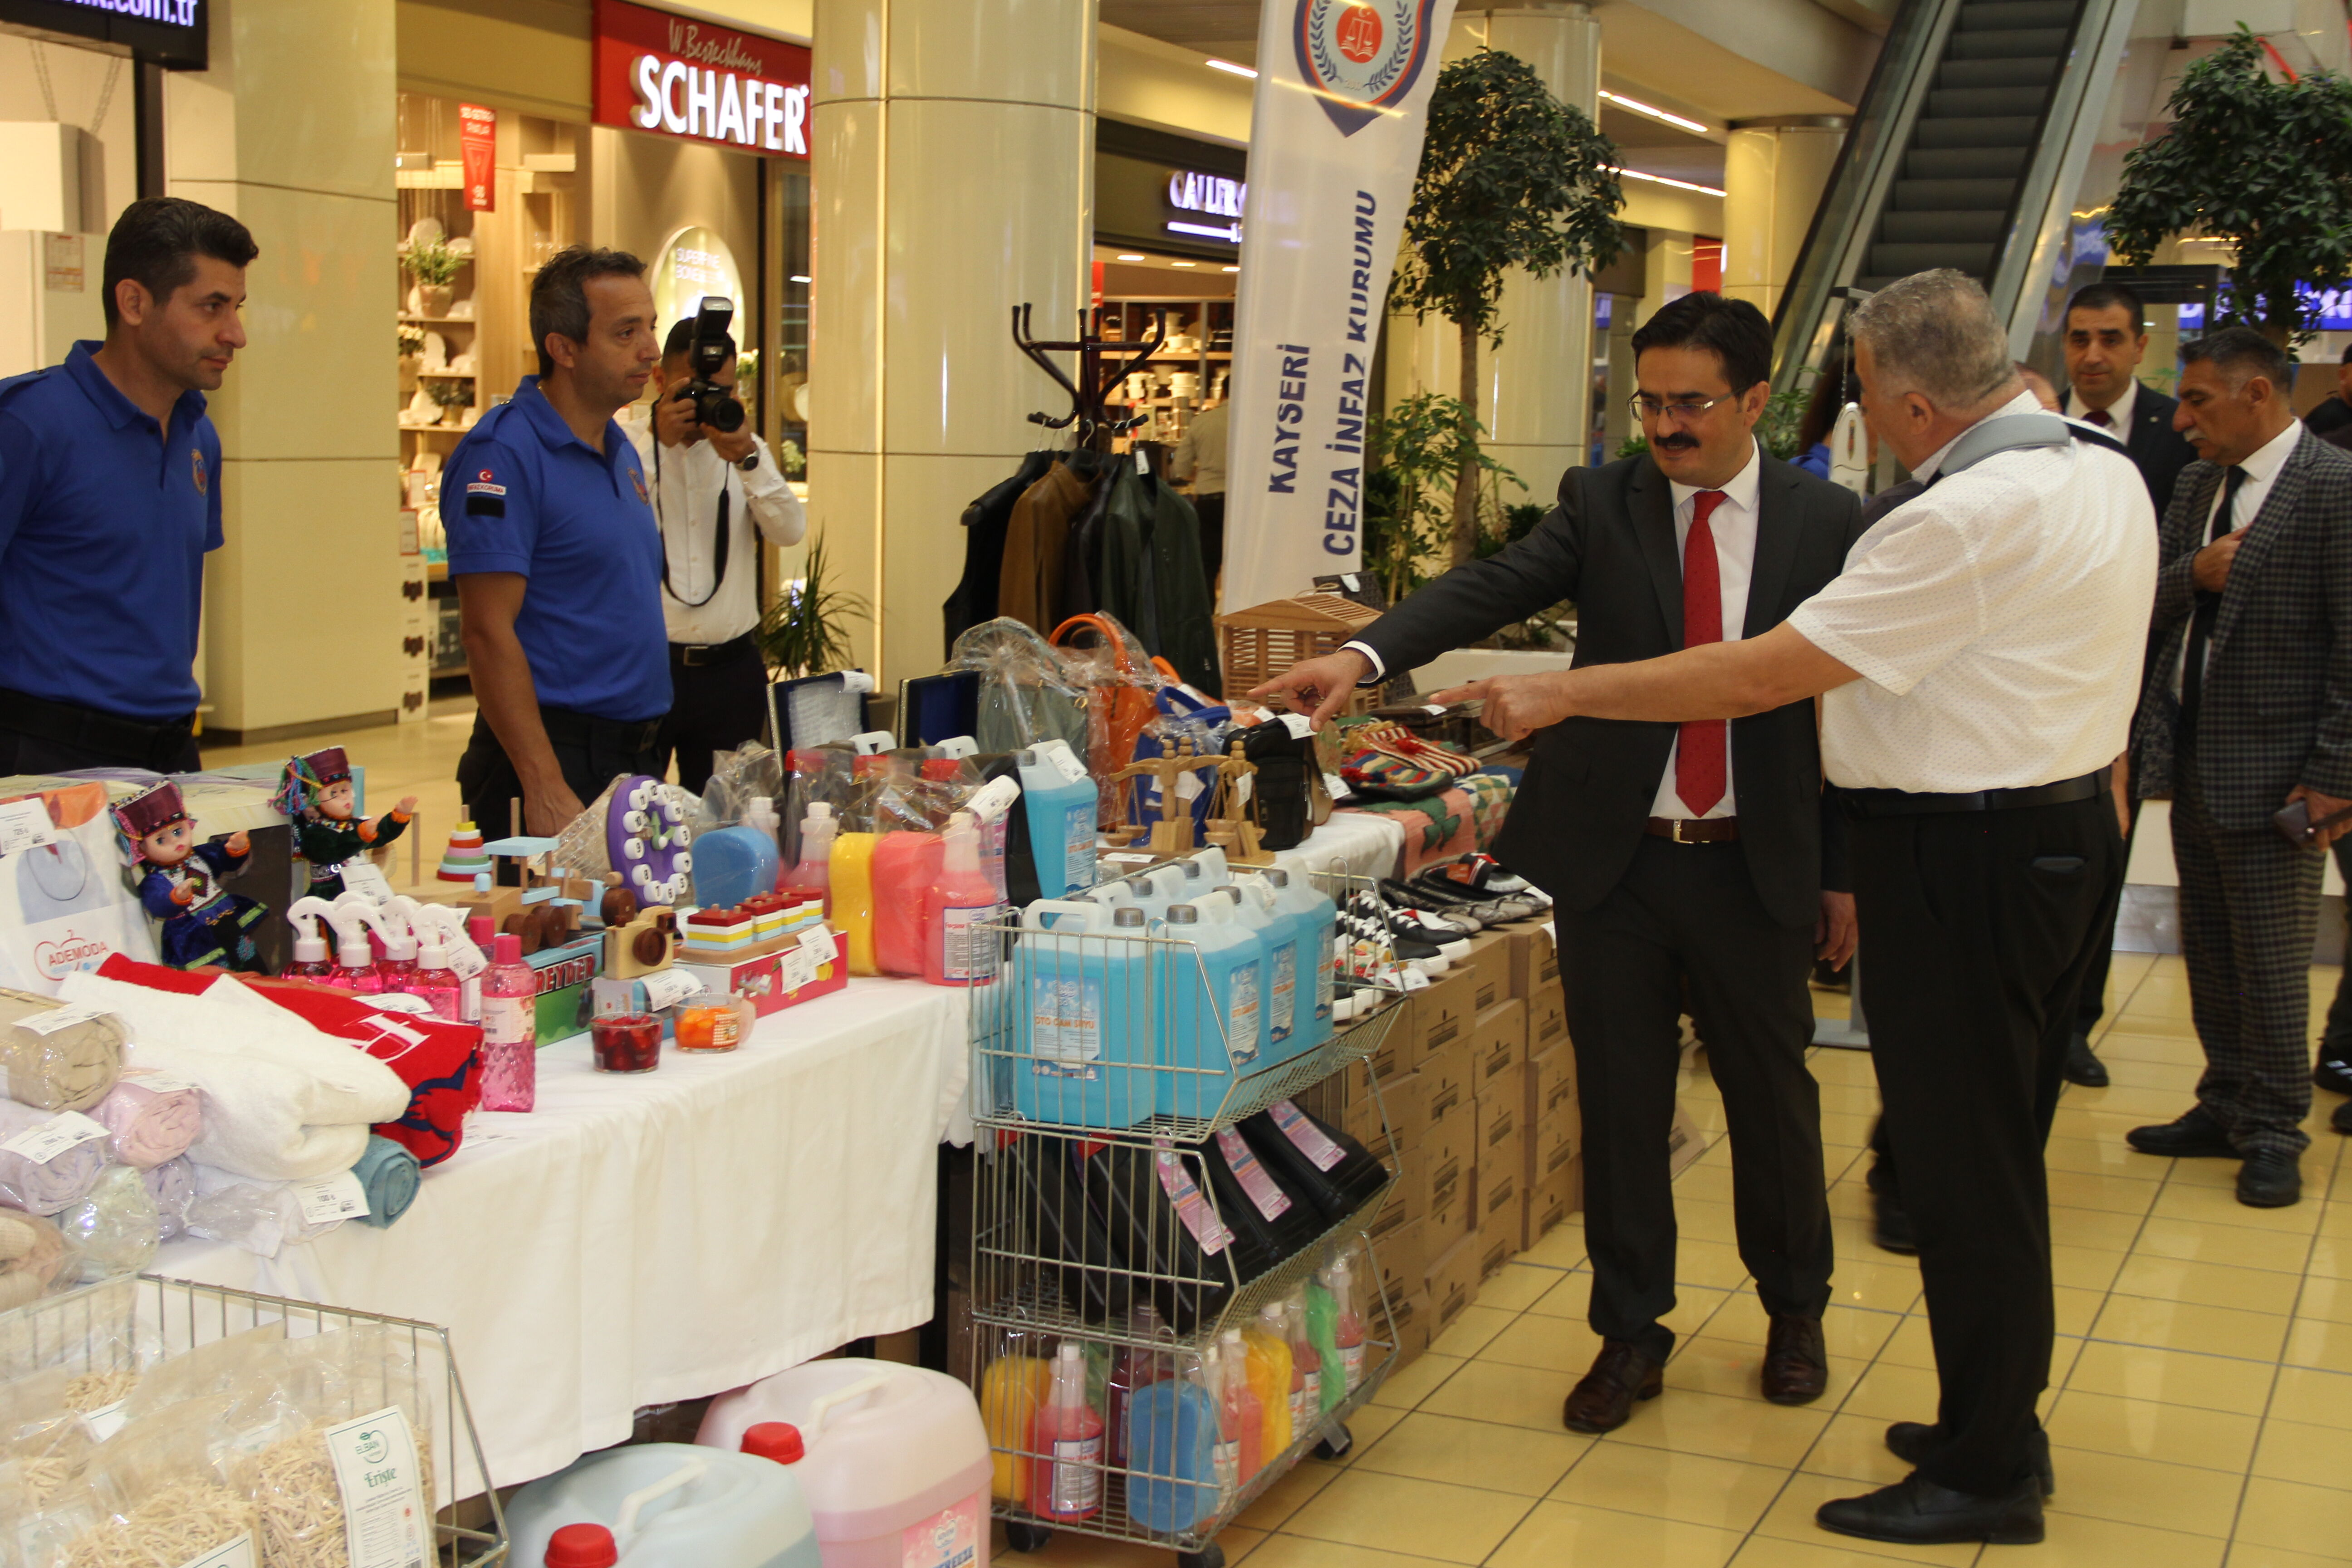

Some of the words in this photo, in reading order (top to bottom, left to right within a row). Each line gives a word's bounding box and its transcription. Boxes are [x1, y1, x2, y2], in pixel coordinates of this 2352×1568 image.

[638, 54, 808, 155] SCHAFER
[1347, 190, 1377, 343] KURUMU
[1268, 343, 1311, 493] KAYSERİ
[1325, 352, 1366, 454] İNFAZ
[1323, 467, 1360, 556] CEZA
[49, 941, 109, 966] ADEMODA
[534, 954, 595, 995] REYDER
[1035, 1016, 1051, 1025] OTO
[364, 1468, 397, 1487] Erişte
